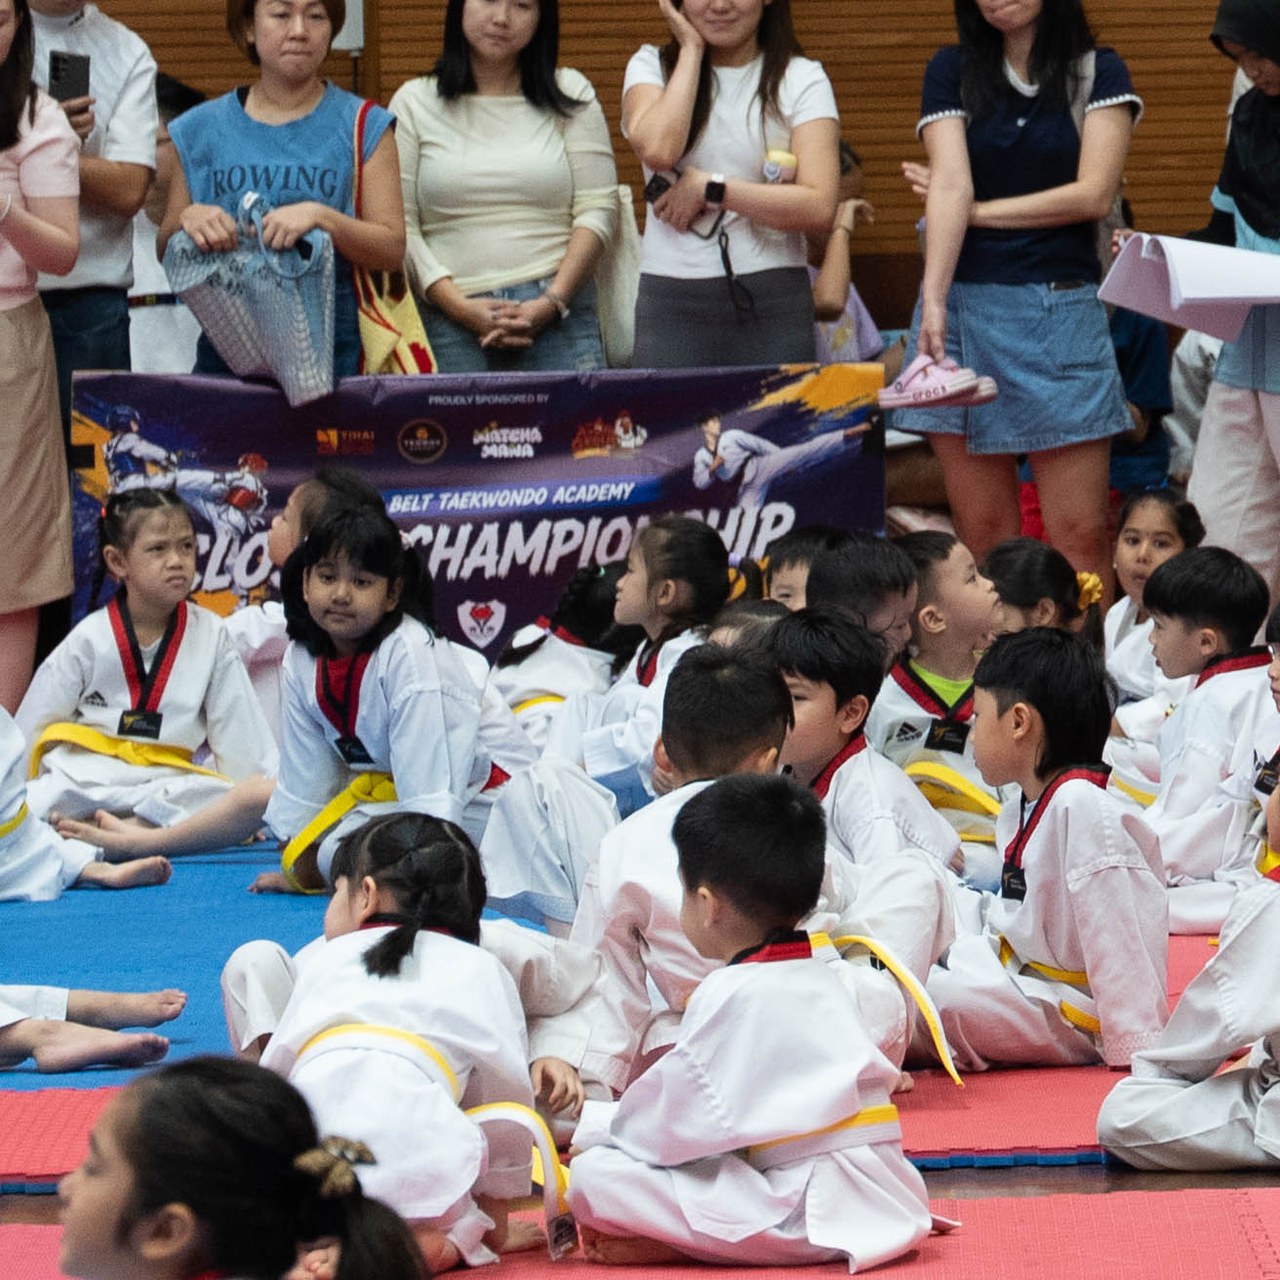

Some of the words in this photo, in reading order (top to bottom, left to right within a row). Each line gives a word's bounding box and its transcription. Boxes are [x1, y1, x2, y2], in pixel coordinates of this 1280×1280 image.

[212, 164, 337, 199] ROWING
[389, 493, 434, 513] BELT
[439, 487, 548, 510] TAEKWONDO
[552, 482, 636, 505] ACADEMY
[408, 501, 796, 582] HAMPIOHIP
